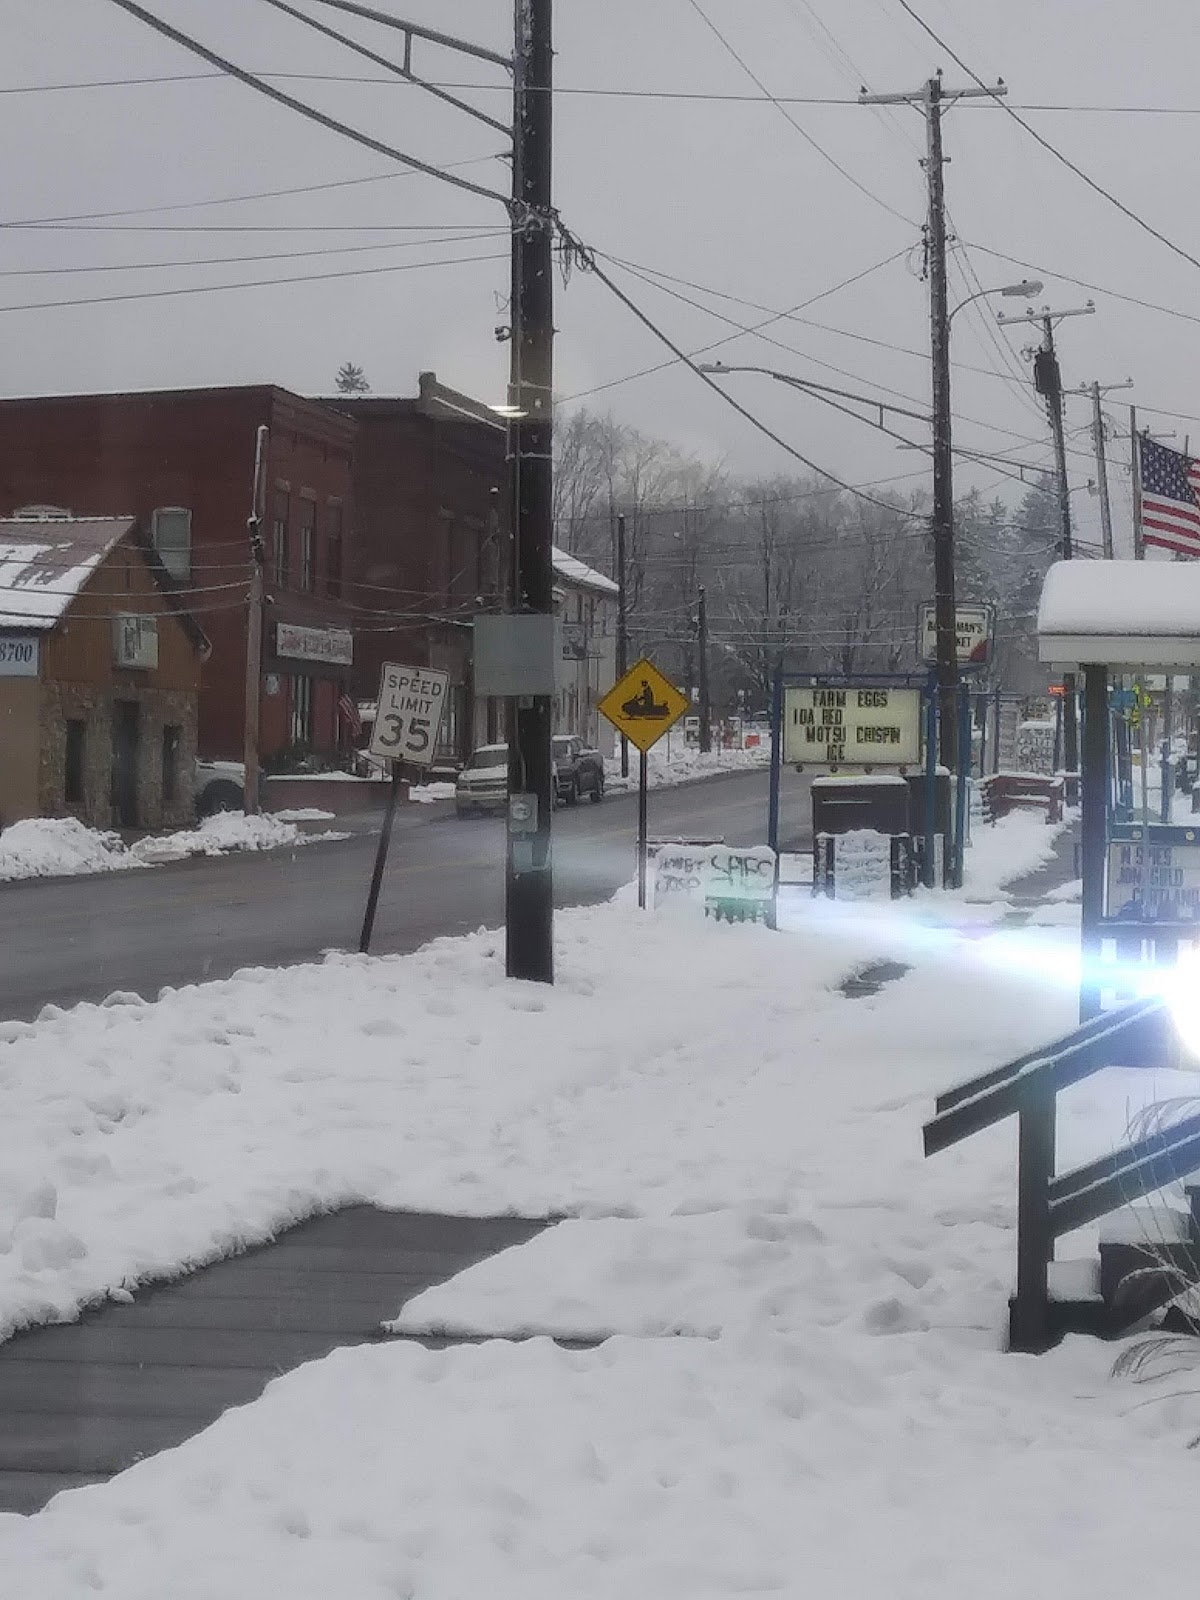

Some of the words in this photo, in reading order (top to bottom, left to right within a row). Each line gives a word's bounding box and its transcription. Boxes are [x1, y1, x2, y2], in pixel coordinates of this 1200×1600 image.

[389, 675, 441, 696] SPEED
[390, 694, 433, 714] LIMIT
[813, 690, 847, 707] FARM
[857, 690, 889, 708] EGGS
[794, 708, 815, 725] IDA
[822, 708, 843, 725] RED
[380, 714, 430, 753] 35
[826, 744, 846, 761] ICE
